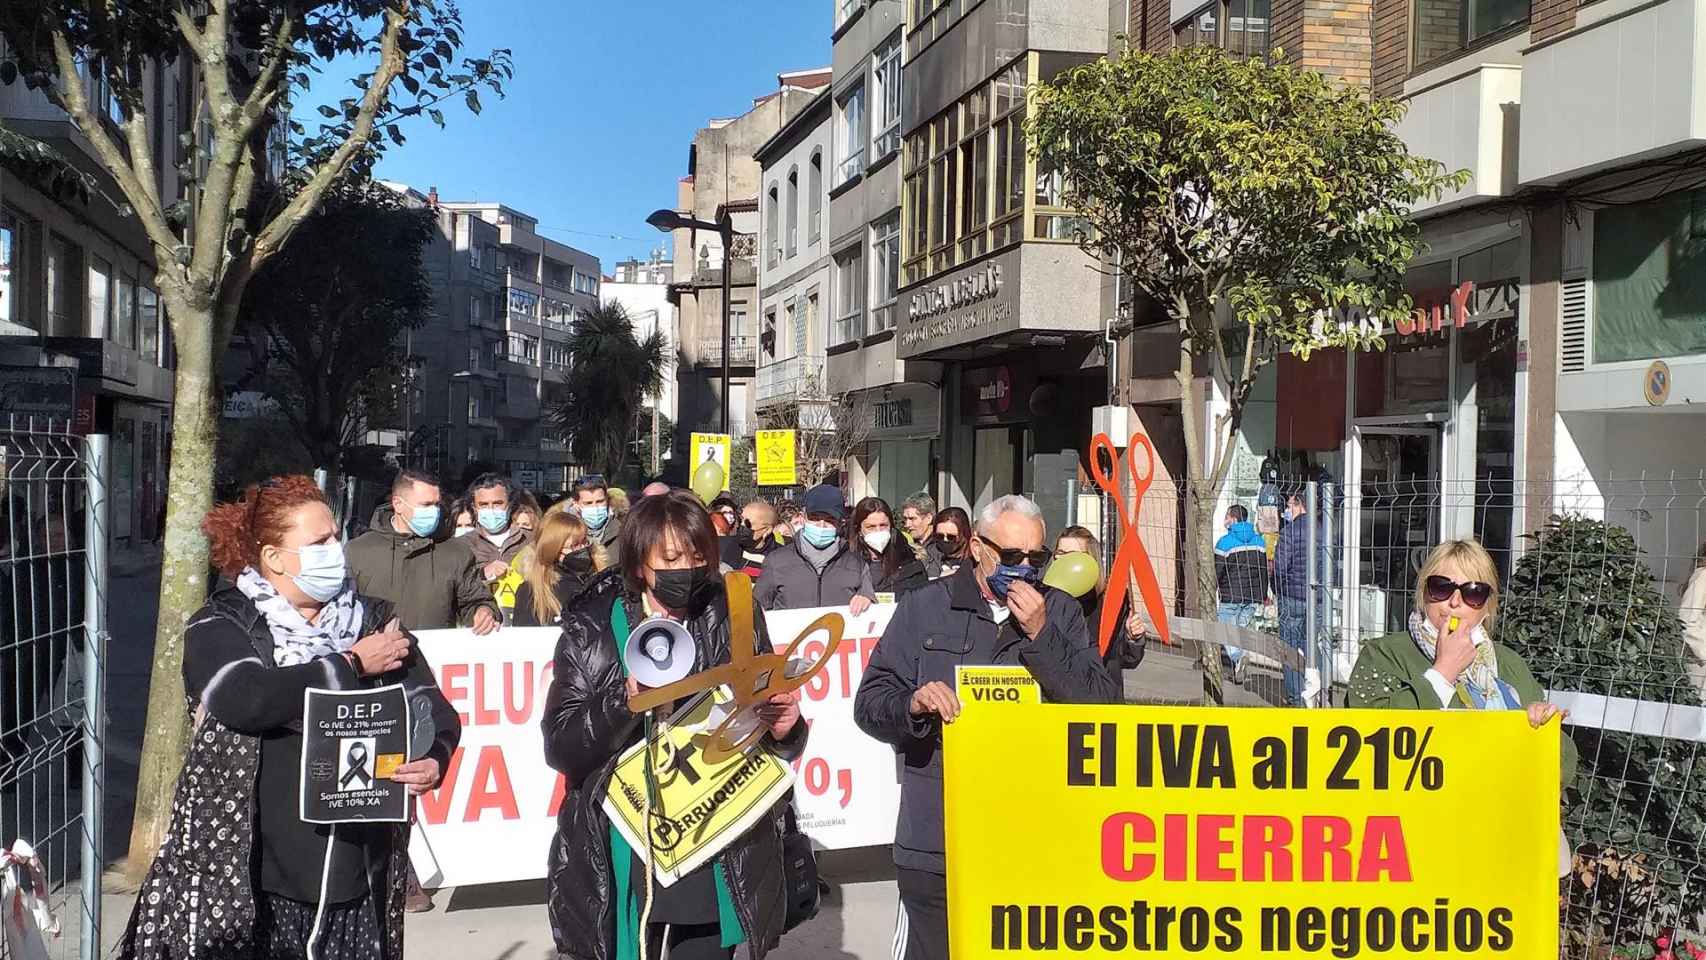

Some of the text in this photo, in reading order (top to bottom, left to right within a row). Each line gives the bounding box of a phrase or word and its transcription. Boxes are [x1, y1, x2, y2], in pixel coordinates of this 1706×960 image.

[971, 677, 1035, 685] CREER EN NOSOTROS
[972, 688, 1020, 702] VIGO
[337, 703, 382, 719] D.E.P
[320, 721, 330, 729] Co
[332, 721, 345, 729] IVE
[354, 721, 370, 729] 21%
[360, 727, 391, 737] negocios
[1068, 723, 1444, 792] El IVA al 21%
[320, 788, 390, 801] Somos esenciais
[328, 797, 381, 808] IVE 10% XA
[803, 818, 846, 829] PELUQUERÍAS
[1102, 812, 1412, 882] CIERRA
[991, 899, 1515, 959] nuestros negocios
